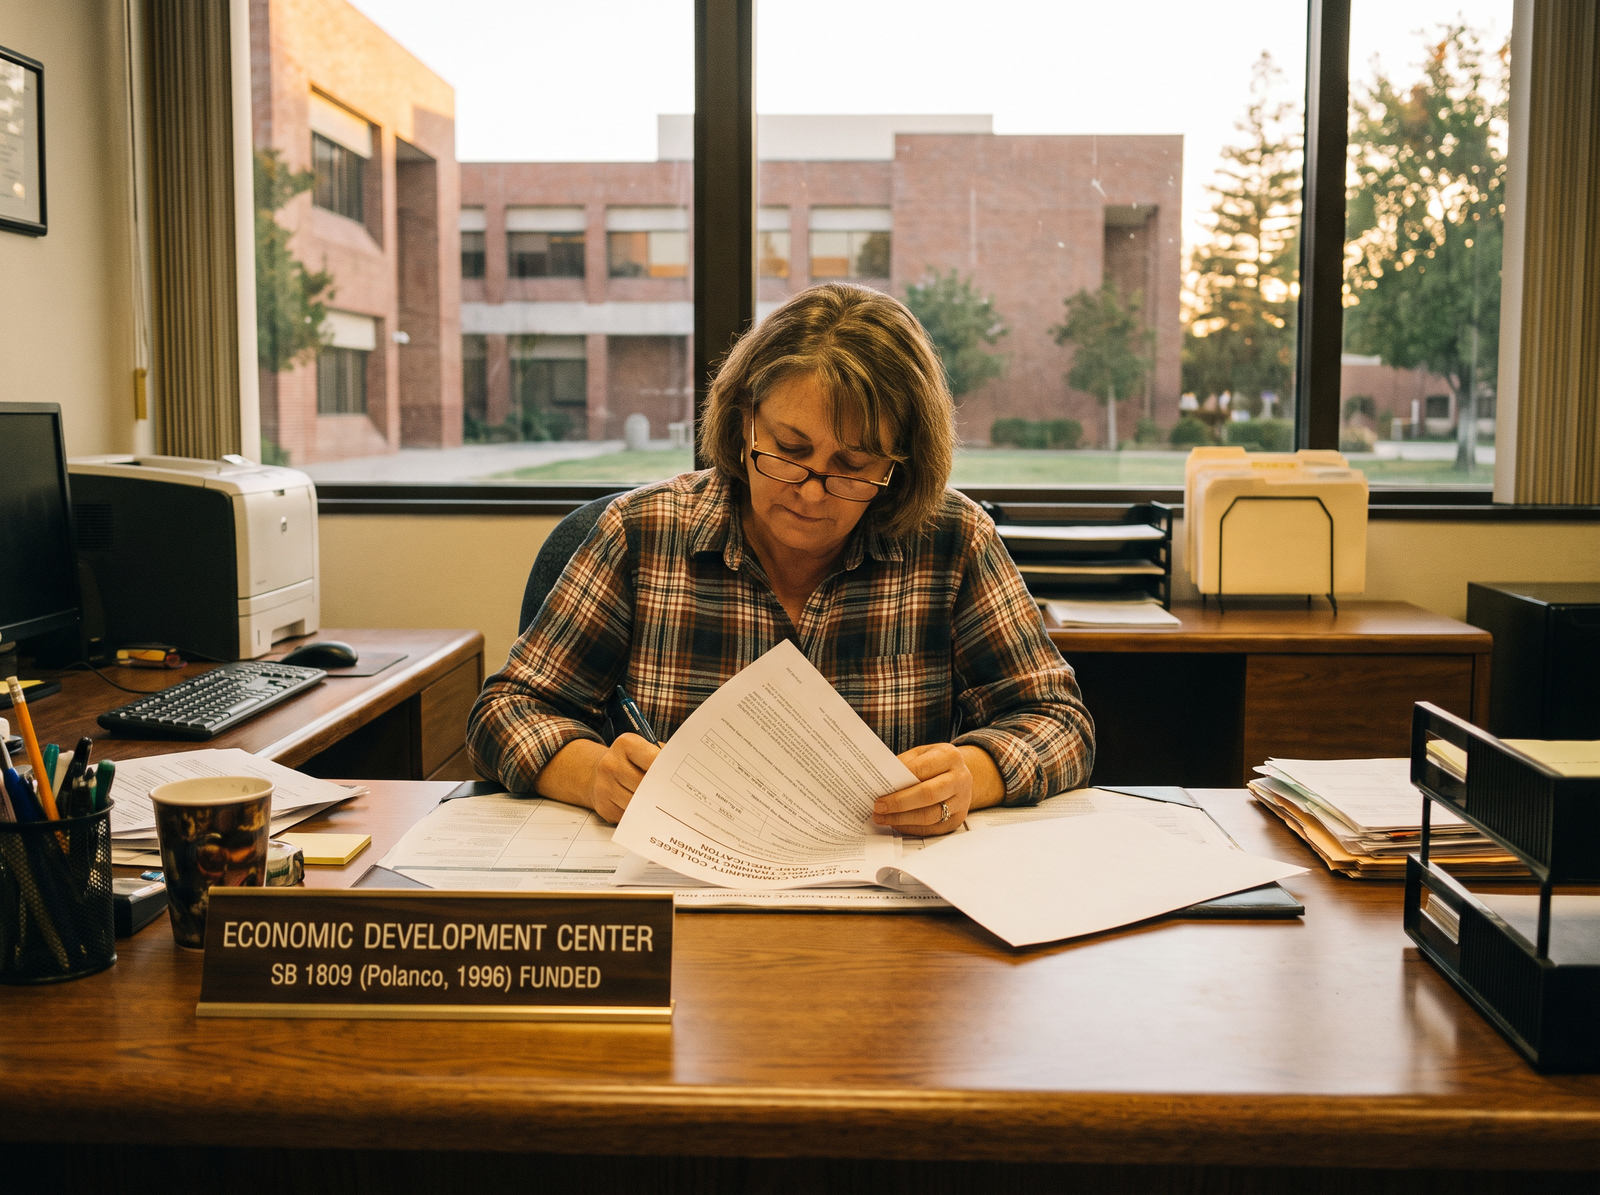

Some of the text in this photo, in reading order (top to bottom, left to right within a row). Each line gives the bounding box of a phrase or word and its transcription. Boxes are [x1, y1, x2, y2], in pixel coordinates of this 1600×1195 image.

[649, 836, 708, 867] COLLEGES
[723, 861, 775, 875] TRAINING
[222, 921, 654, 953] ECONOMIC DEVELOPMENT CENTER
[270, 963, 601, 992] SB 1809 (Polanco, 1996) FUNDED
